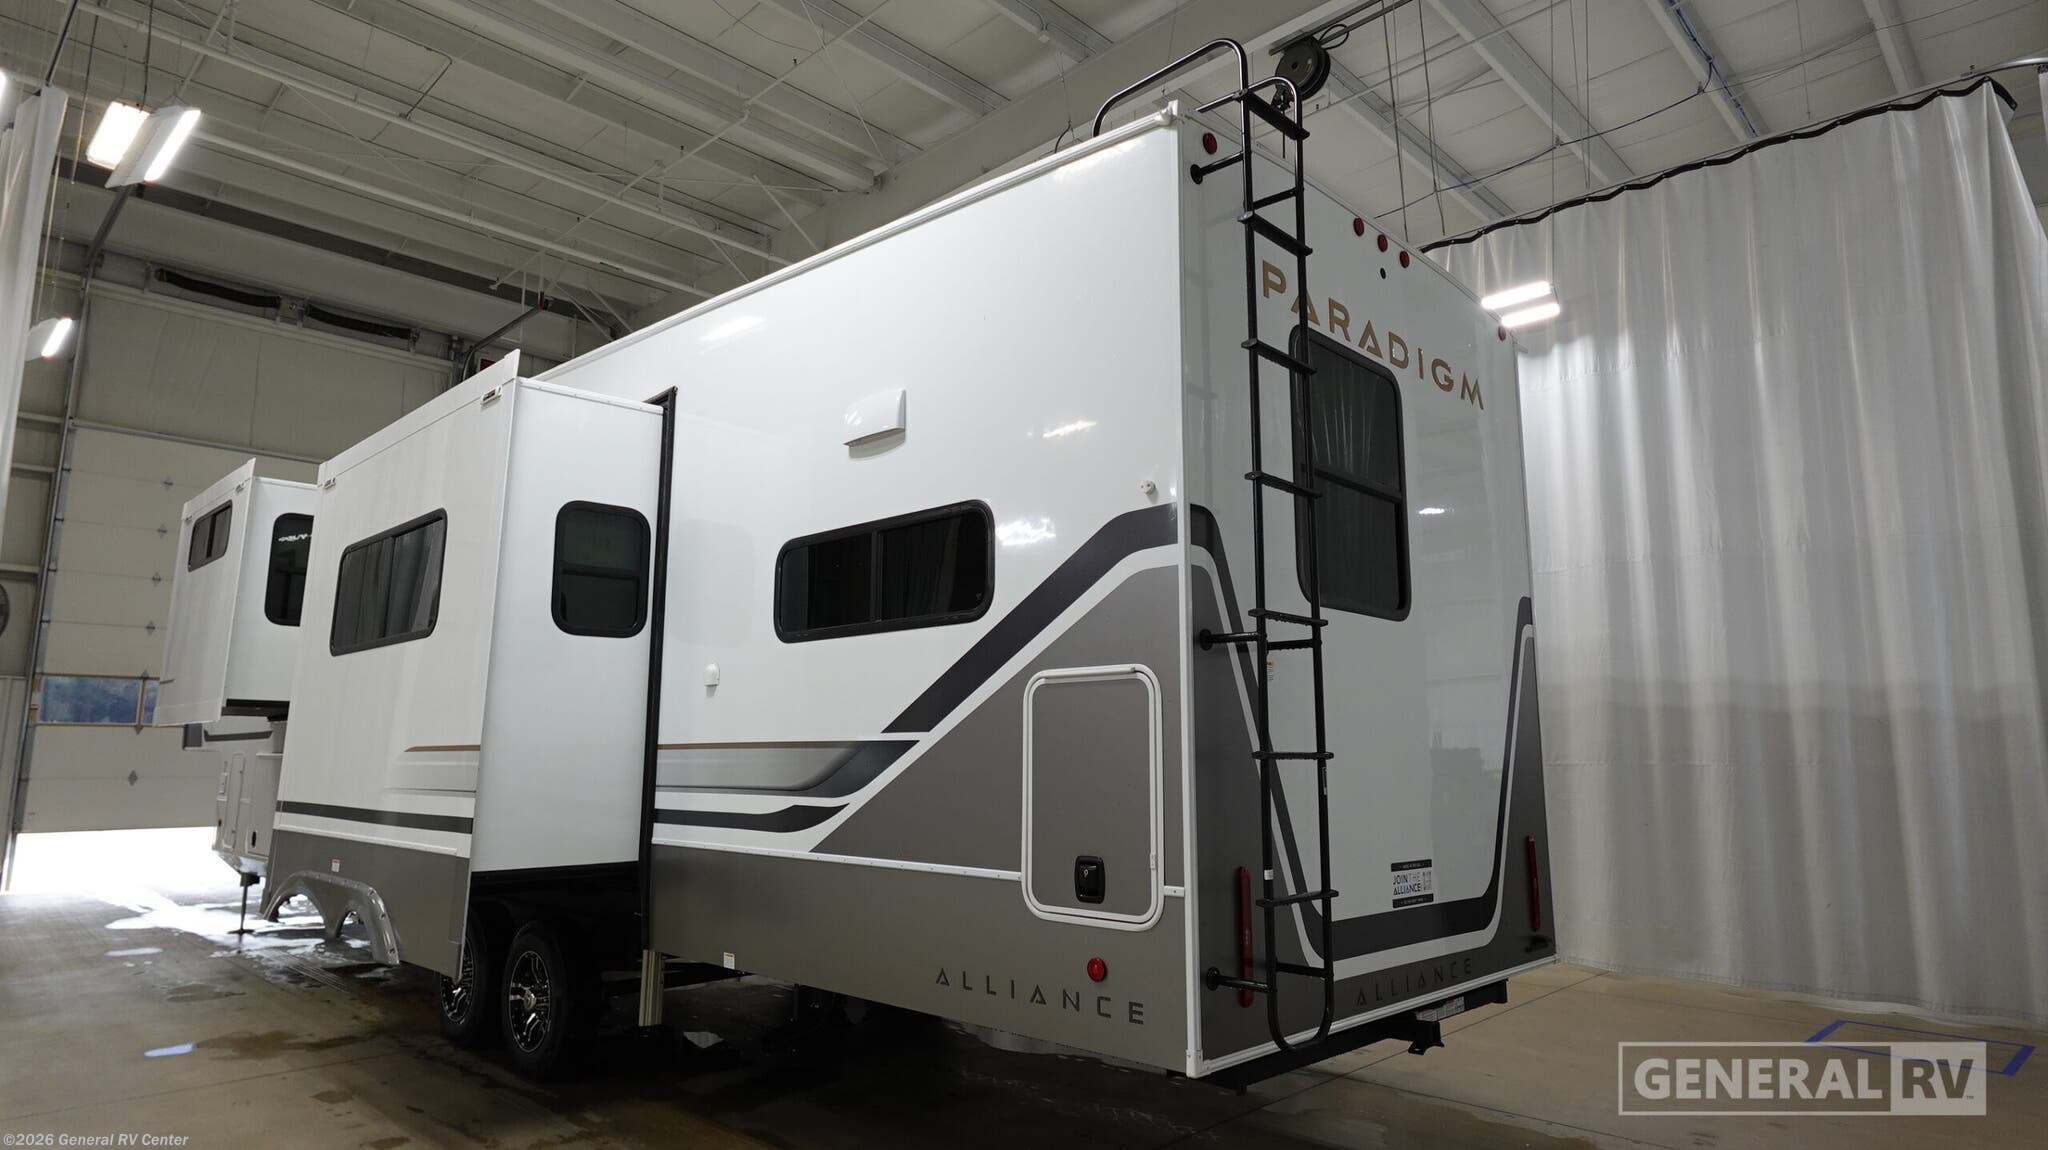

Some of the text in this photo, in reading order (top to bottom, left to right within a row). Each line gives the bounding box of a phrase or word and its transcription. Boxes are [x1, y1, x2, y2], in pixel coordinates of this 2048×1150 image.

[1262, 259, 1484, 410] PARADIGM
[1393, 874, 1408, 885] JOIN
[1393, 883, 1421, 895] ALLIANCE
[935, 967, 1145, 1025] ALLIANCE
[1356, 958, 1472, 1007] ALLIANCE
